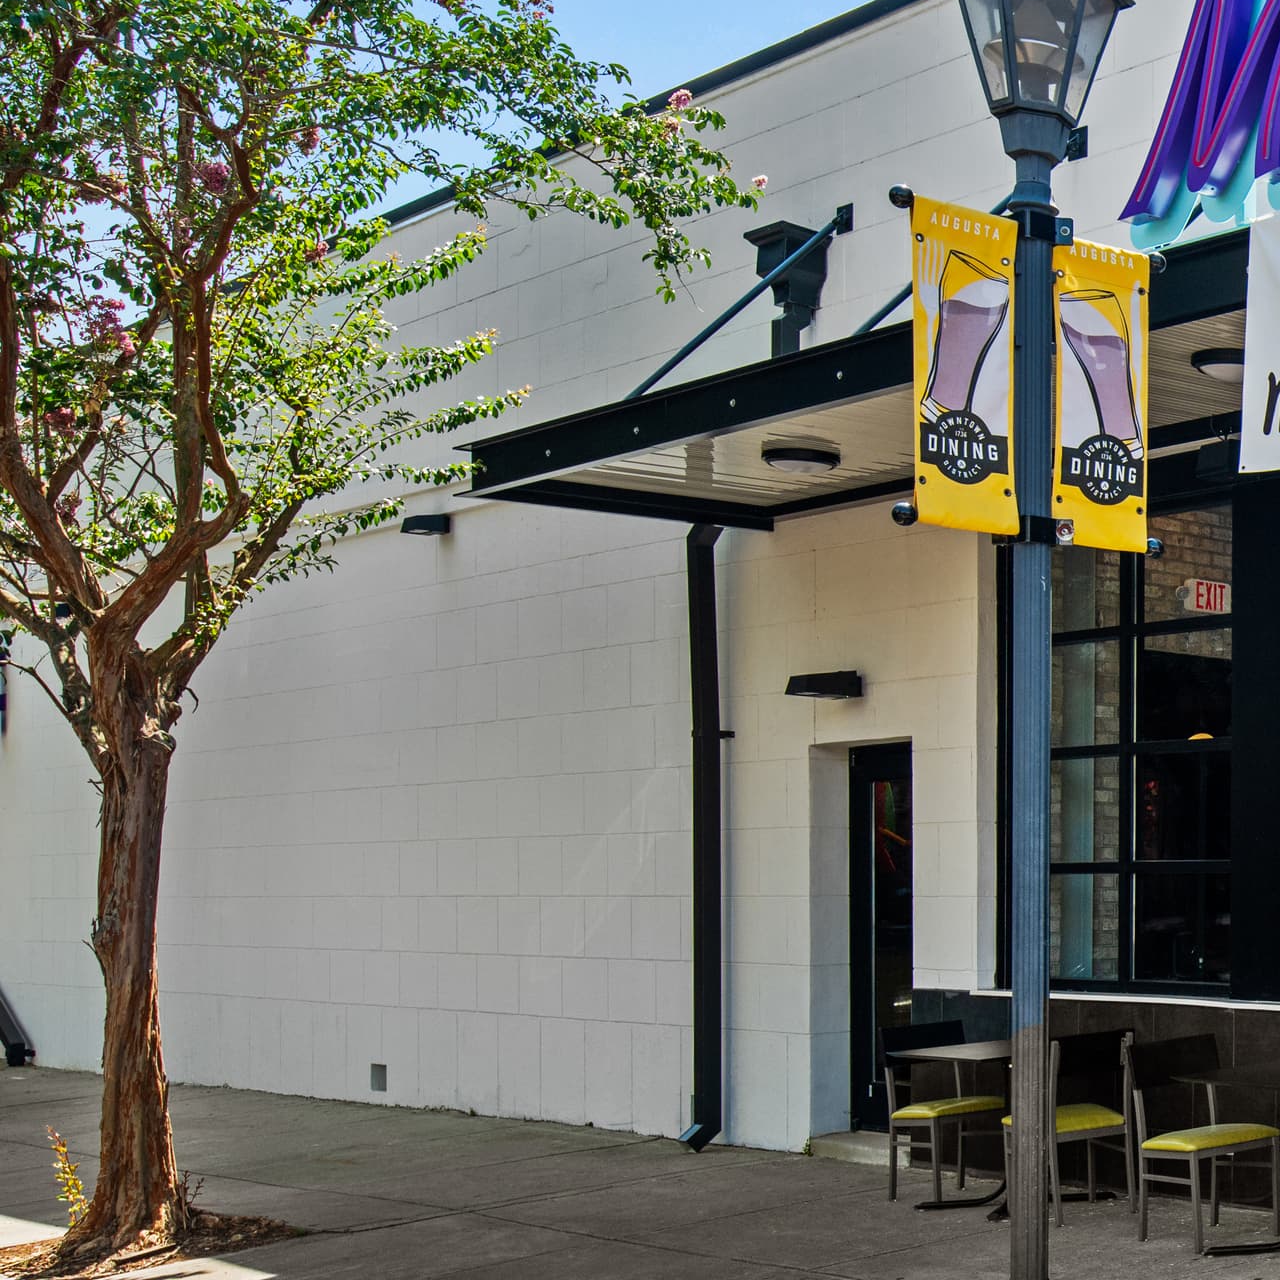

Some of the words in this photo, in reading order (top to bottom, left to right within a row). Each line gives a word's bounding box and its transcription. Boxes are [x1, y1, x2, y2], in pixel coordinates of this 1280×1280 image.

[930, 211, 1000, 240] AUGUSTA
[1069, 244, 1134, 270] AUGUSTA
[928, 434, 998, 461] DINING
[1083, 440, 1128, 463] DOWNTOWN
[943, 460, 981, 478] DISTRICT
[1071, 457, 1137, 484] DINING
[1087, 481, 1122, 500] DISTRICT
[1195, 581, 1226, 612] EXIT
